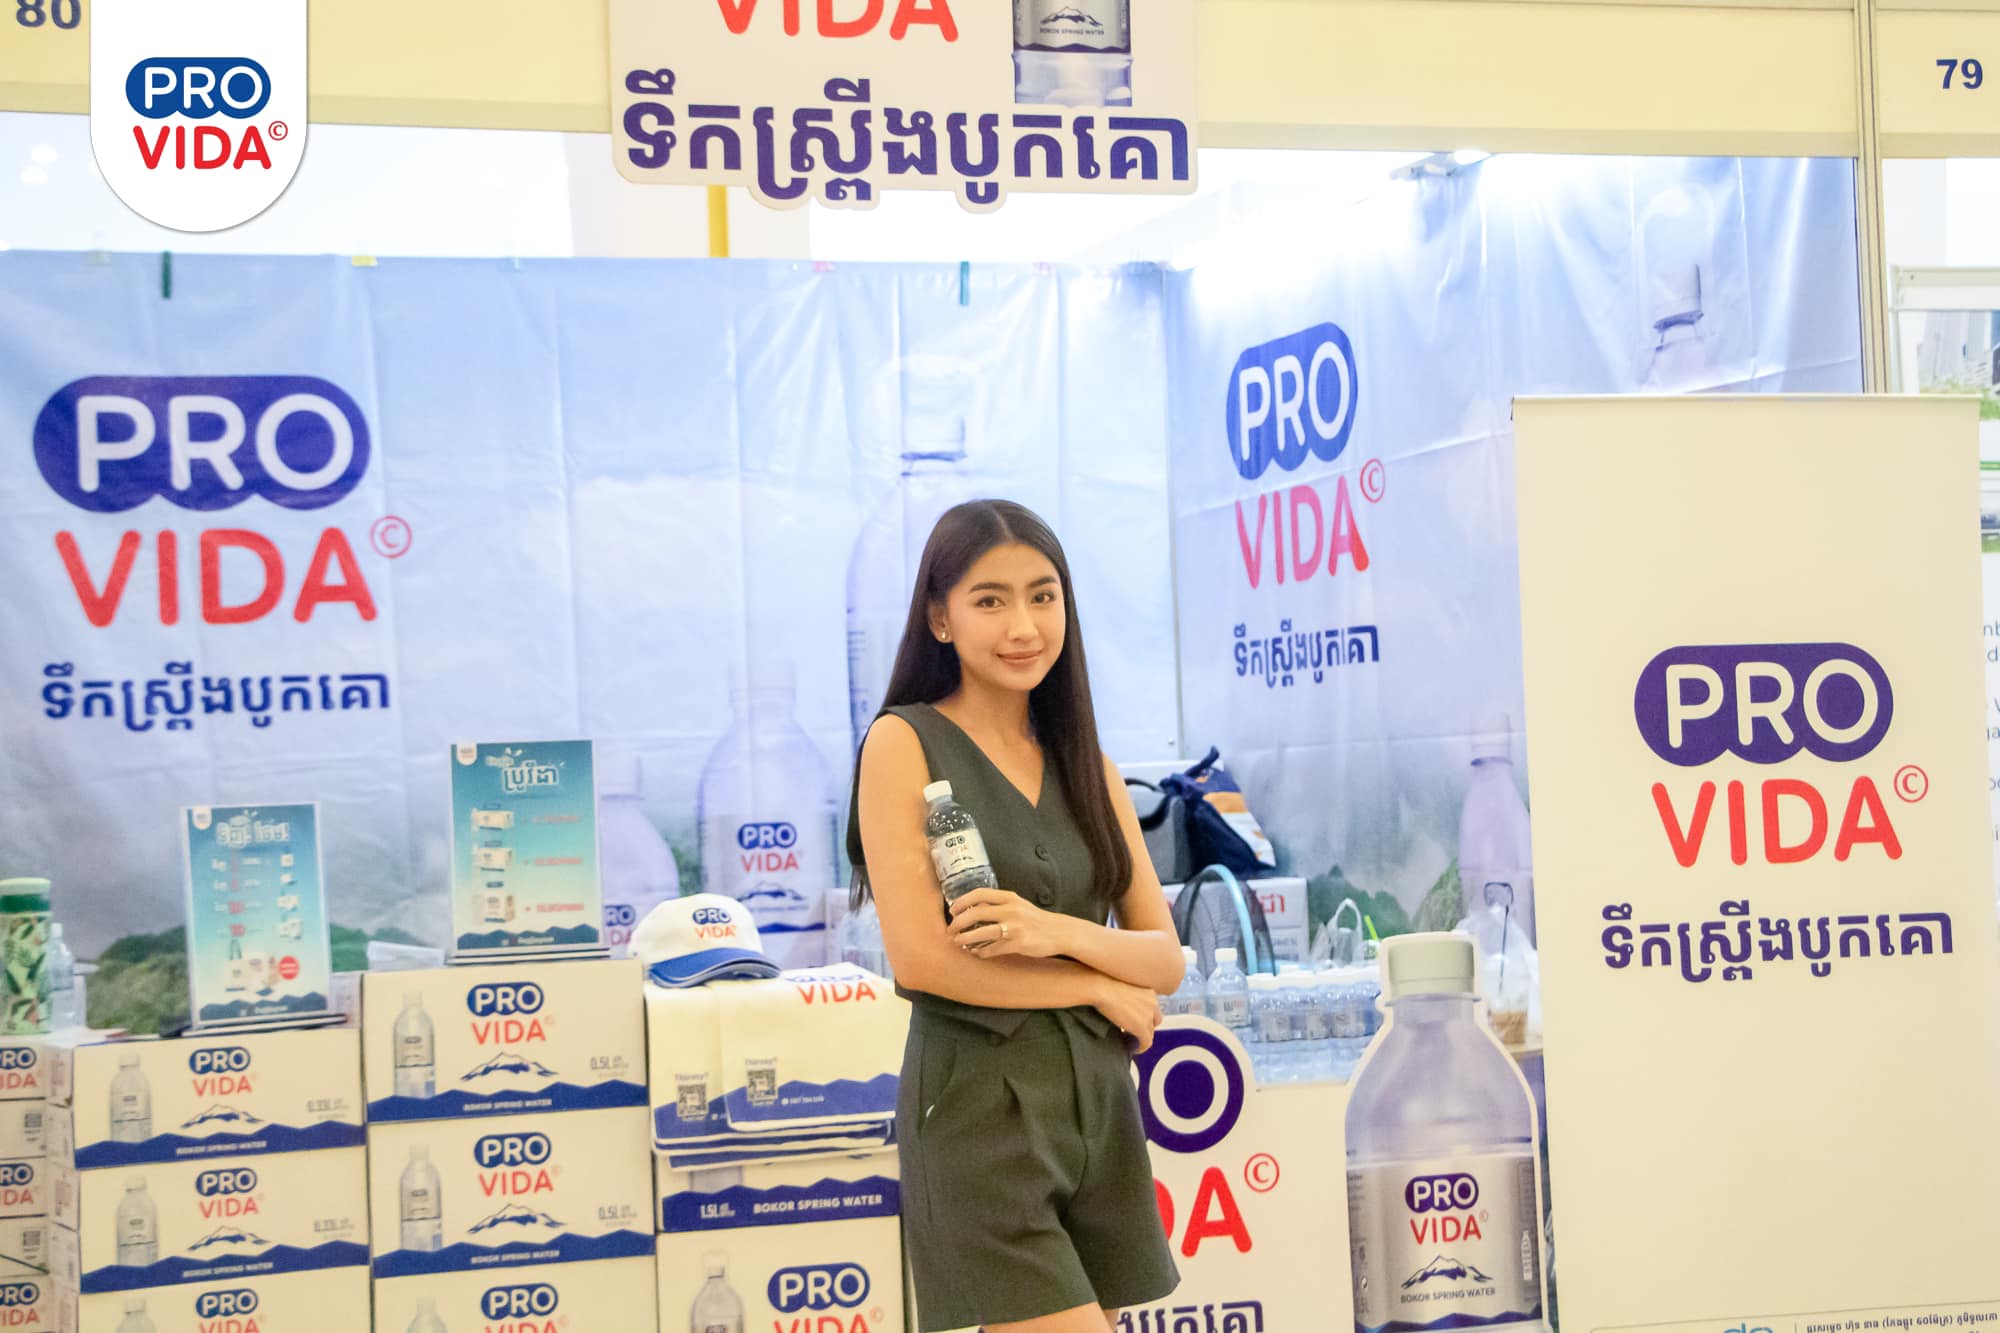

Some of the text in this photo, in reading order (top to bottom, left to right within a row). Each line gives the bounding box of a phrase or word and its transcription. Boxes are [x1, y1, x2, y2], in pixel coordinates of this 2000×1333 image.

[16, 0, 81, 29] 80
[1936, 58, 1983, 90] 79
[1239, 341, 1350, 461] PRO
[76, 393, 354, 492] PRO
[1235, 475, 1369, 589] VIDA
[54, 527, 378, 628] VIDA
[1666, 658, 1878, 749] PRO
[1651, 776, 1902, 868] VIDA
[743, 825, 795, 847] PRO
[741, 852, 799, 872] VIDA
[605, 905, 634, 926] RO
[695, 909, 731, 922] PRO
[694, 926, 735, 938] VIDA
[475, 985, 541, 1013] PRO
[796, 982, 877, 1005] VIDA
[471, 1017, 546, 1046] VIDA
[2, 1050, 34, 1067] RO
[196, 1050, 248, 1071] PRO
[0, 1072, 38, 1089] IDA
[192, 1075, 253, 1097] VIDA
[482, 1135, 548, 1164] PRO
[0, 1167, 32, 1182] RO
[202, 1170, 255, 1193] PRO
[478, 1168, 554, 1197] VIDA
[753, 1194, 882, 1214] BOKOR SPRING WATER
[1413, 1177, 1476, 1209] PRO
[199, 1197, 259, 1218] VIDA
[1410, 1214, 1482, 1245] VIDA
[779, 1267, 866, 1308] PRO
[1433, 1290, 1465, 1300] SPRING
[1466, 1287, 1496, 1297] WATER
[202, 1291, 256, 1315] PRO
[489, 1286, 555, 1317] PRO
[2, 1308, 40, 1327] IDA
